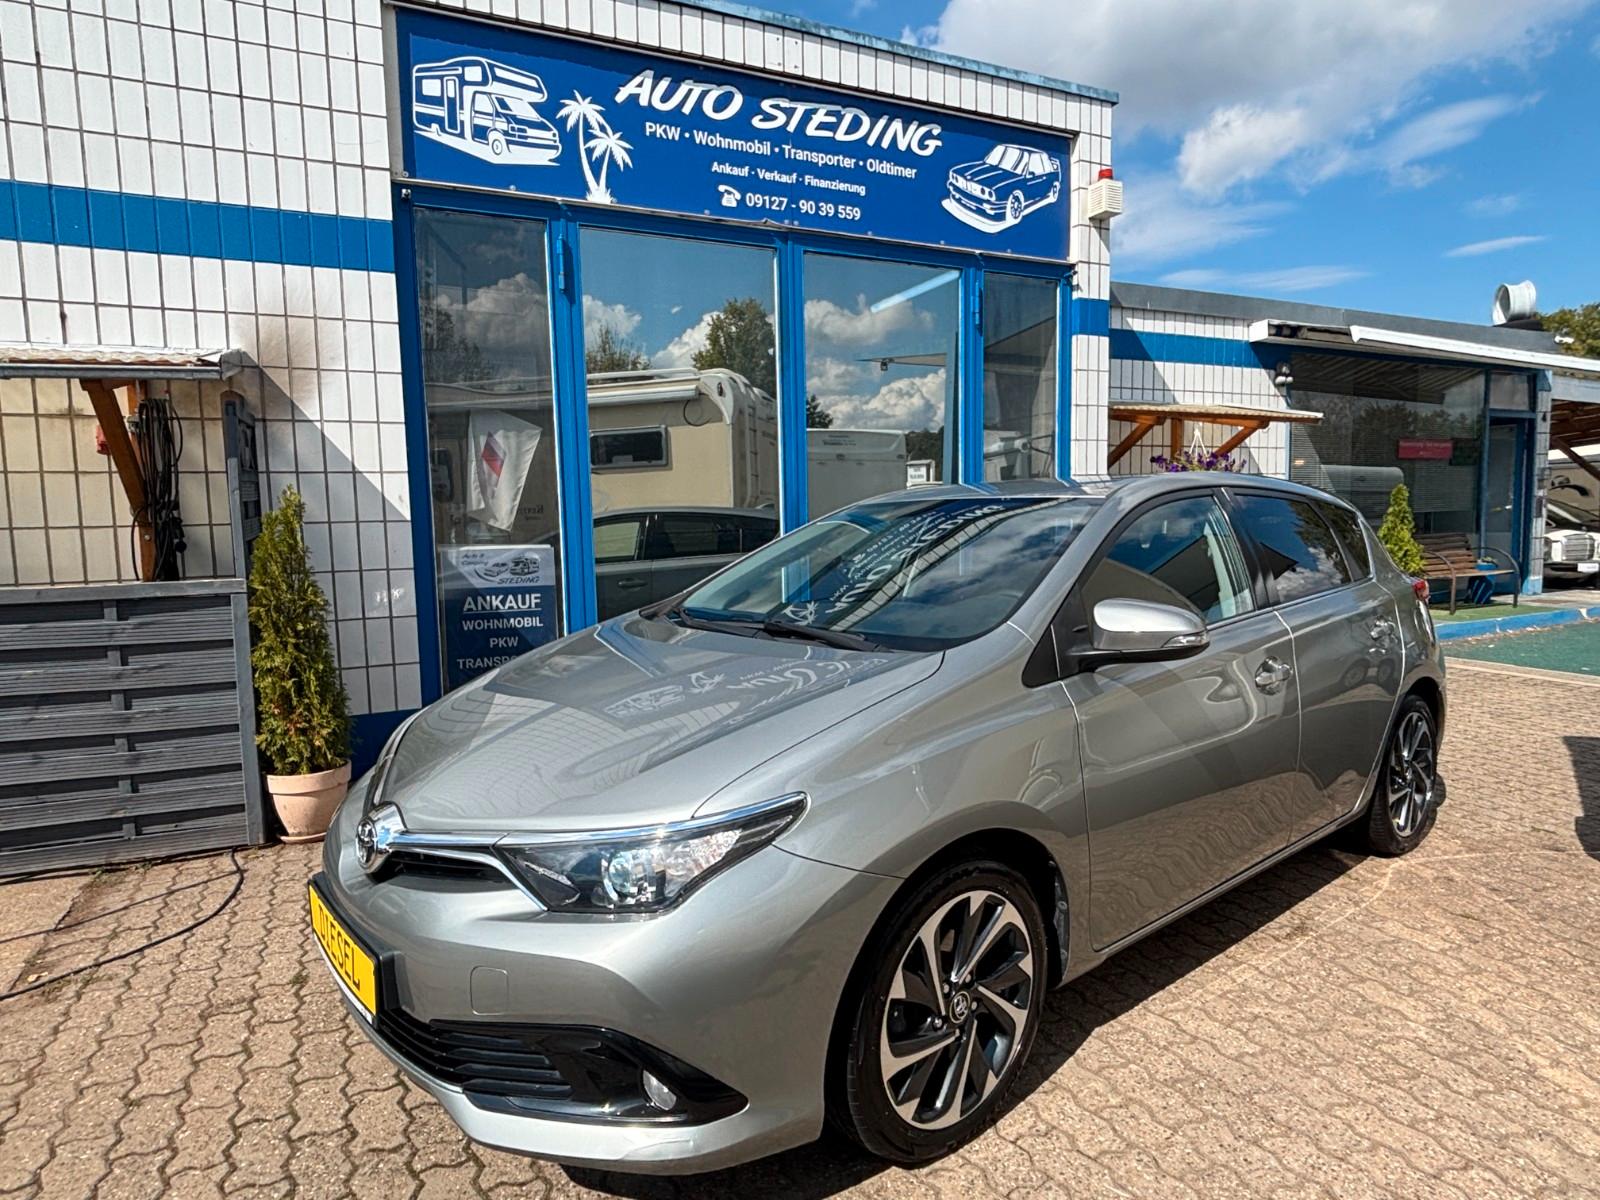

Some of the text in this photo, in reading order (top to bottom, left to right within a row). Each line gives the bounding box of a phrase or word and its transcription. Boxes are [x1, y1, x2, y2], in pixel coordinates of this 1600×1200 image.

[615, 69, 943, 157] AUTO STEDING
[645, 121, 917, 179] PKW Wohnmobil Transporter Oldtimer
[711, 161, 866, 197] Ankauf Verkauf Finanzierung
[745, 193, 788, 211] 09127
[799, 199, 816, 215] 90
[818, 203, 835, 217] 39
[838, 205, 861, 221] 559
[463, 593, 542, 612] ANKAUF
[462, 616, 544, 631] WOHNMOBIL
[489, 636, 519, 649] PKW
[318, 903, 361, 992] DIESEL
